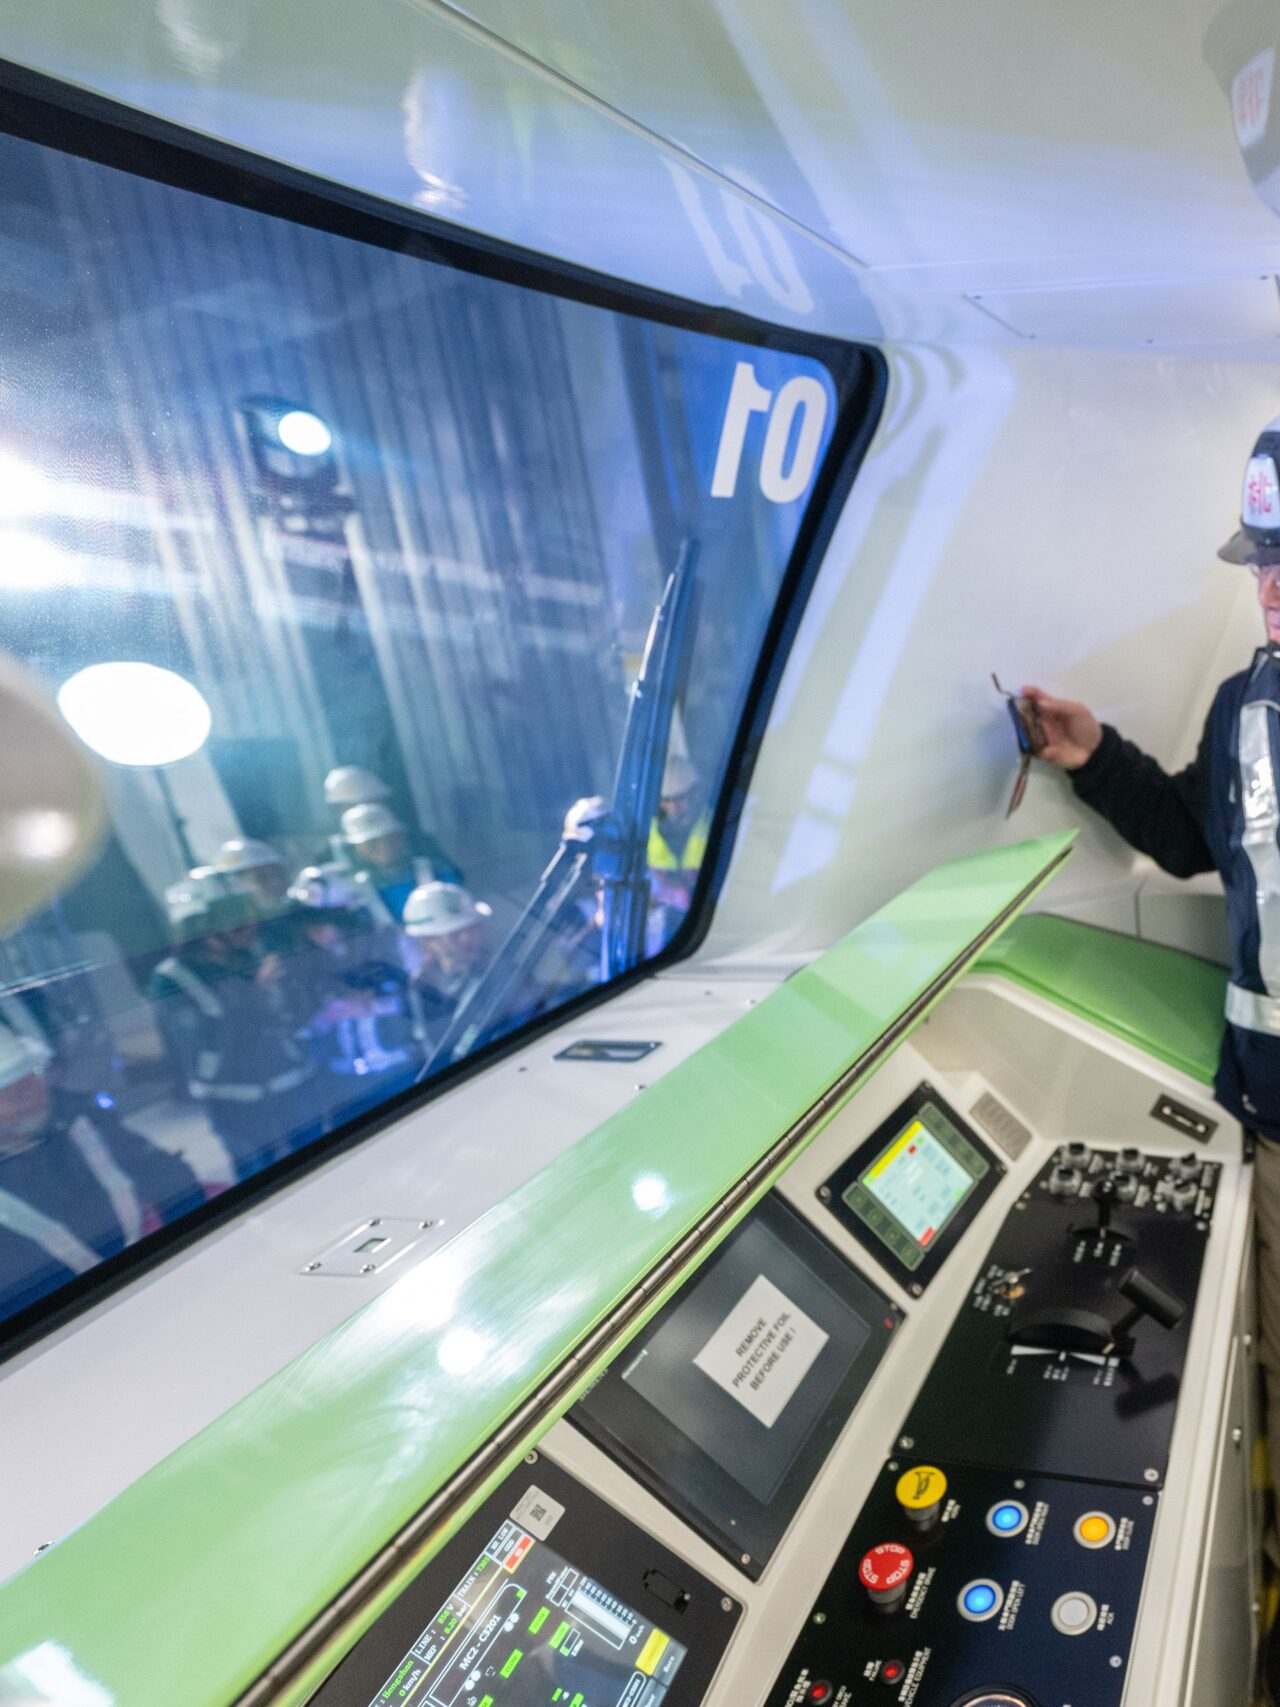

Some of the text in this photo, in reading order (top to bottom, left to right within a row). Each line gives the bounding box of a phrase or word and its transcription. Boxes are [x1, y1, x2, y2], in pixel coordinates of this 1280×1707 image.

[731, 1310, 791, 1388] PROTECTIVE FOIL
[734, 1316, 768, 1357] REMOVE
[748, 1351, 781, 1390] BEFORE
[776, 1332, 793, 1352] USE
[874, 1544, 905, 1554] STOP
[863, 1558, 878, 1584] STOP
[886, 1559, 909, 1584] STOP
[457, 1575, 476, 1597] TRAIN
[414, 1633, 432, 1654] LINE
[423, 1643, 439, 1661] MRP
[458, 1645, 479, 1670] MC2
[477, 1612, 502, 1642] C3201
[381, 1658, 415, 1699] Hengshan
[401, 1667, 422, 1691] km/h
